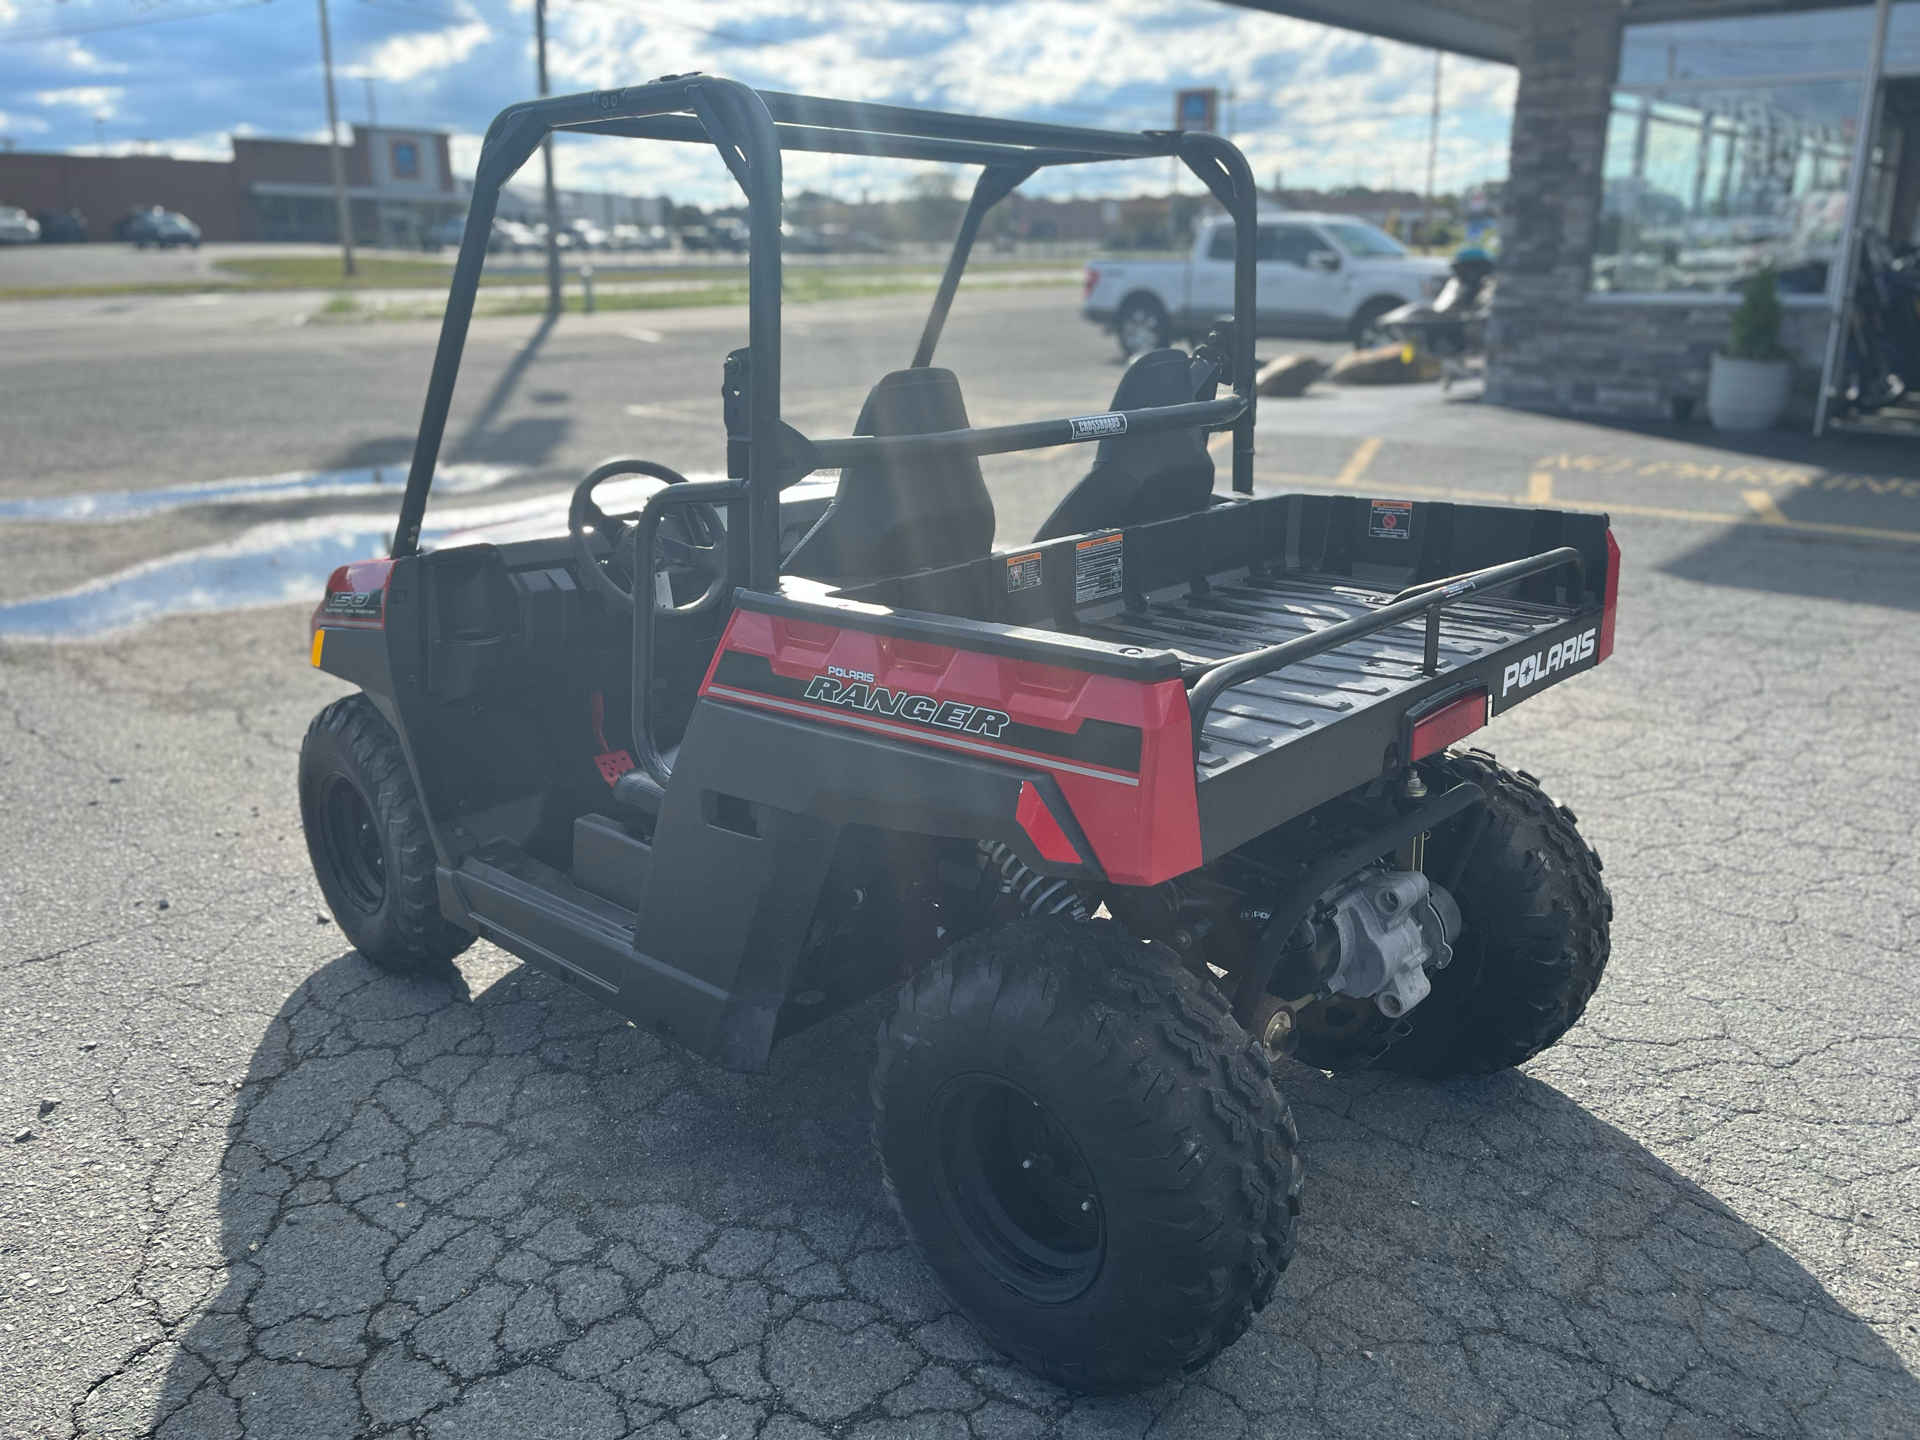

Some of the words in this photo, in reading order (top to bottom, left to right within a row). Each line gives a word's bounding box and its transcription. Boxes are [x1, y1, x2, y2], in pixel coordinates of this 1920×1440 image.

[1078, 417, 1120, 431] CROSSROADS
[330, 592, 370, 607] 150
[1502, 628, 1596, 697] POLARIS
[828, 666, 874, 682] POLARIS
[804, 675, 1010, 738] RANGER
